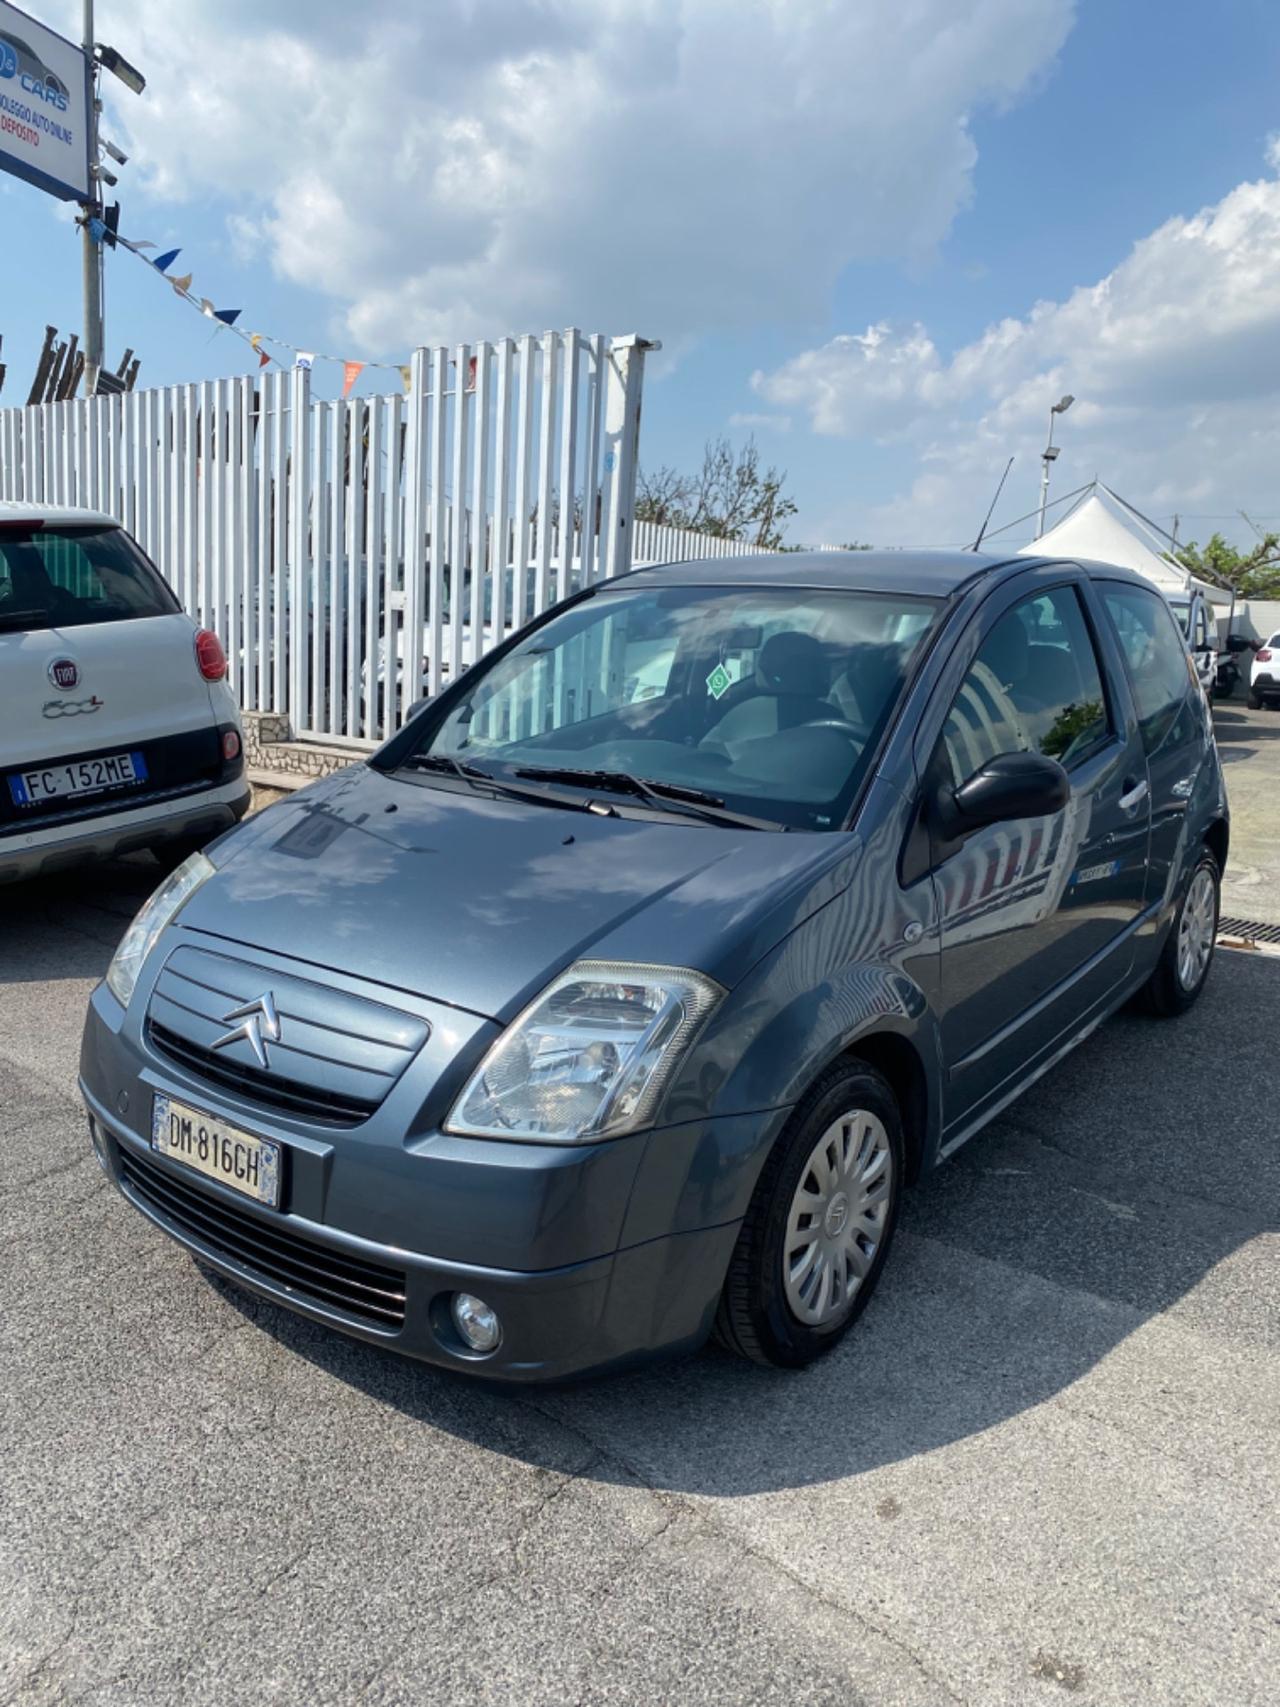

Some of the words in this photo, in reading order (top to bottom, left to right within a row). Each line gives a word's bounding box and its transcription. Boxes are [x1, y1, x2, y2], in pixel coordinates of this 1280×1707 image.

[21, 73, 67, 111] CARS
[1, 114, 40, 147] DEPOSITO
[32, 111, 49, 133] AUTO
[50, 121, 72, 146] ONLINE
